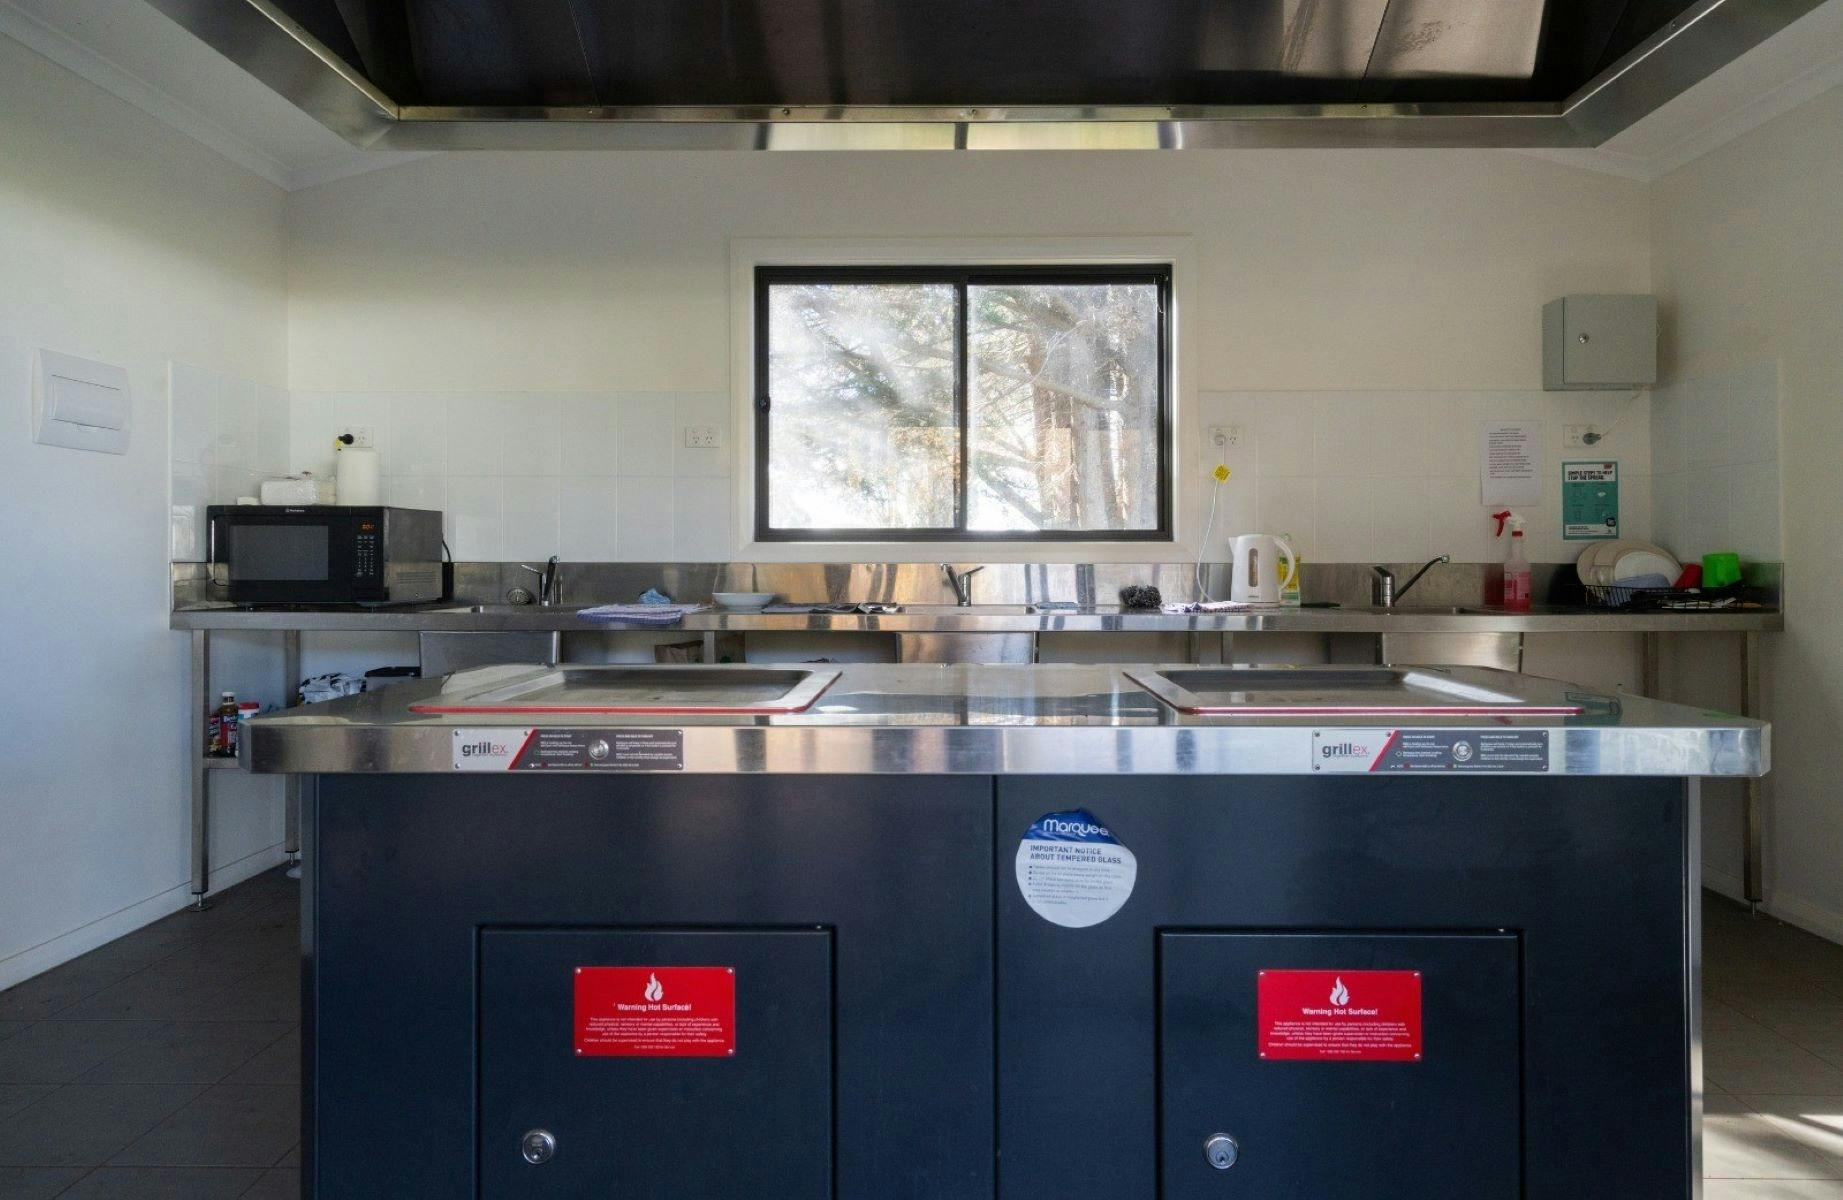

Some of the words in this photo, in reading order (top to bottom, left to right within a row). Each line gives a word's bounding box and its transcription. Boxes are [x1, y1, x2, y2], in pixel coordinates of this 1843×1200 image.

[1030, 844, 1073, 853] IMPORTANT
[1057, 855, 1096, 863] TEMPERED
[617, 1003, 647, 1012] Warning
[648, 1003, 661, 1011] Hot
[662, 1003, 692, 1011] Surface!
[1302, 1007, 1332, 1016] Warning
[1348, 1007, 1378, 1015] Surface!
